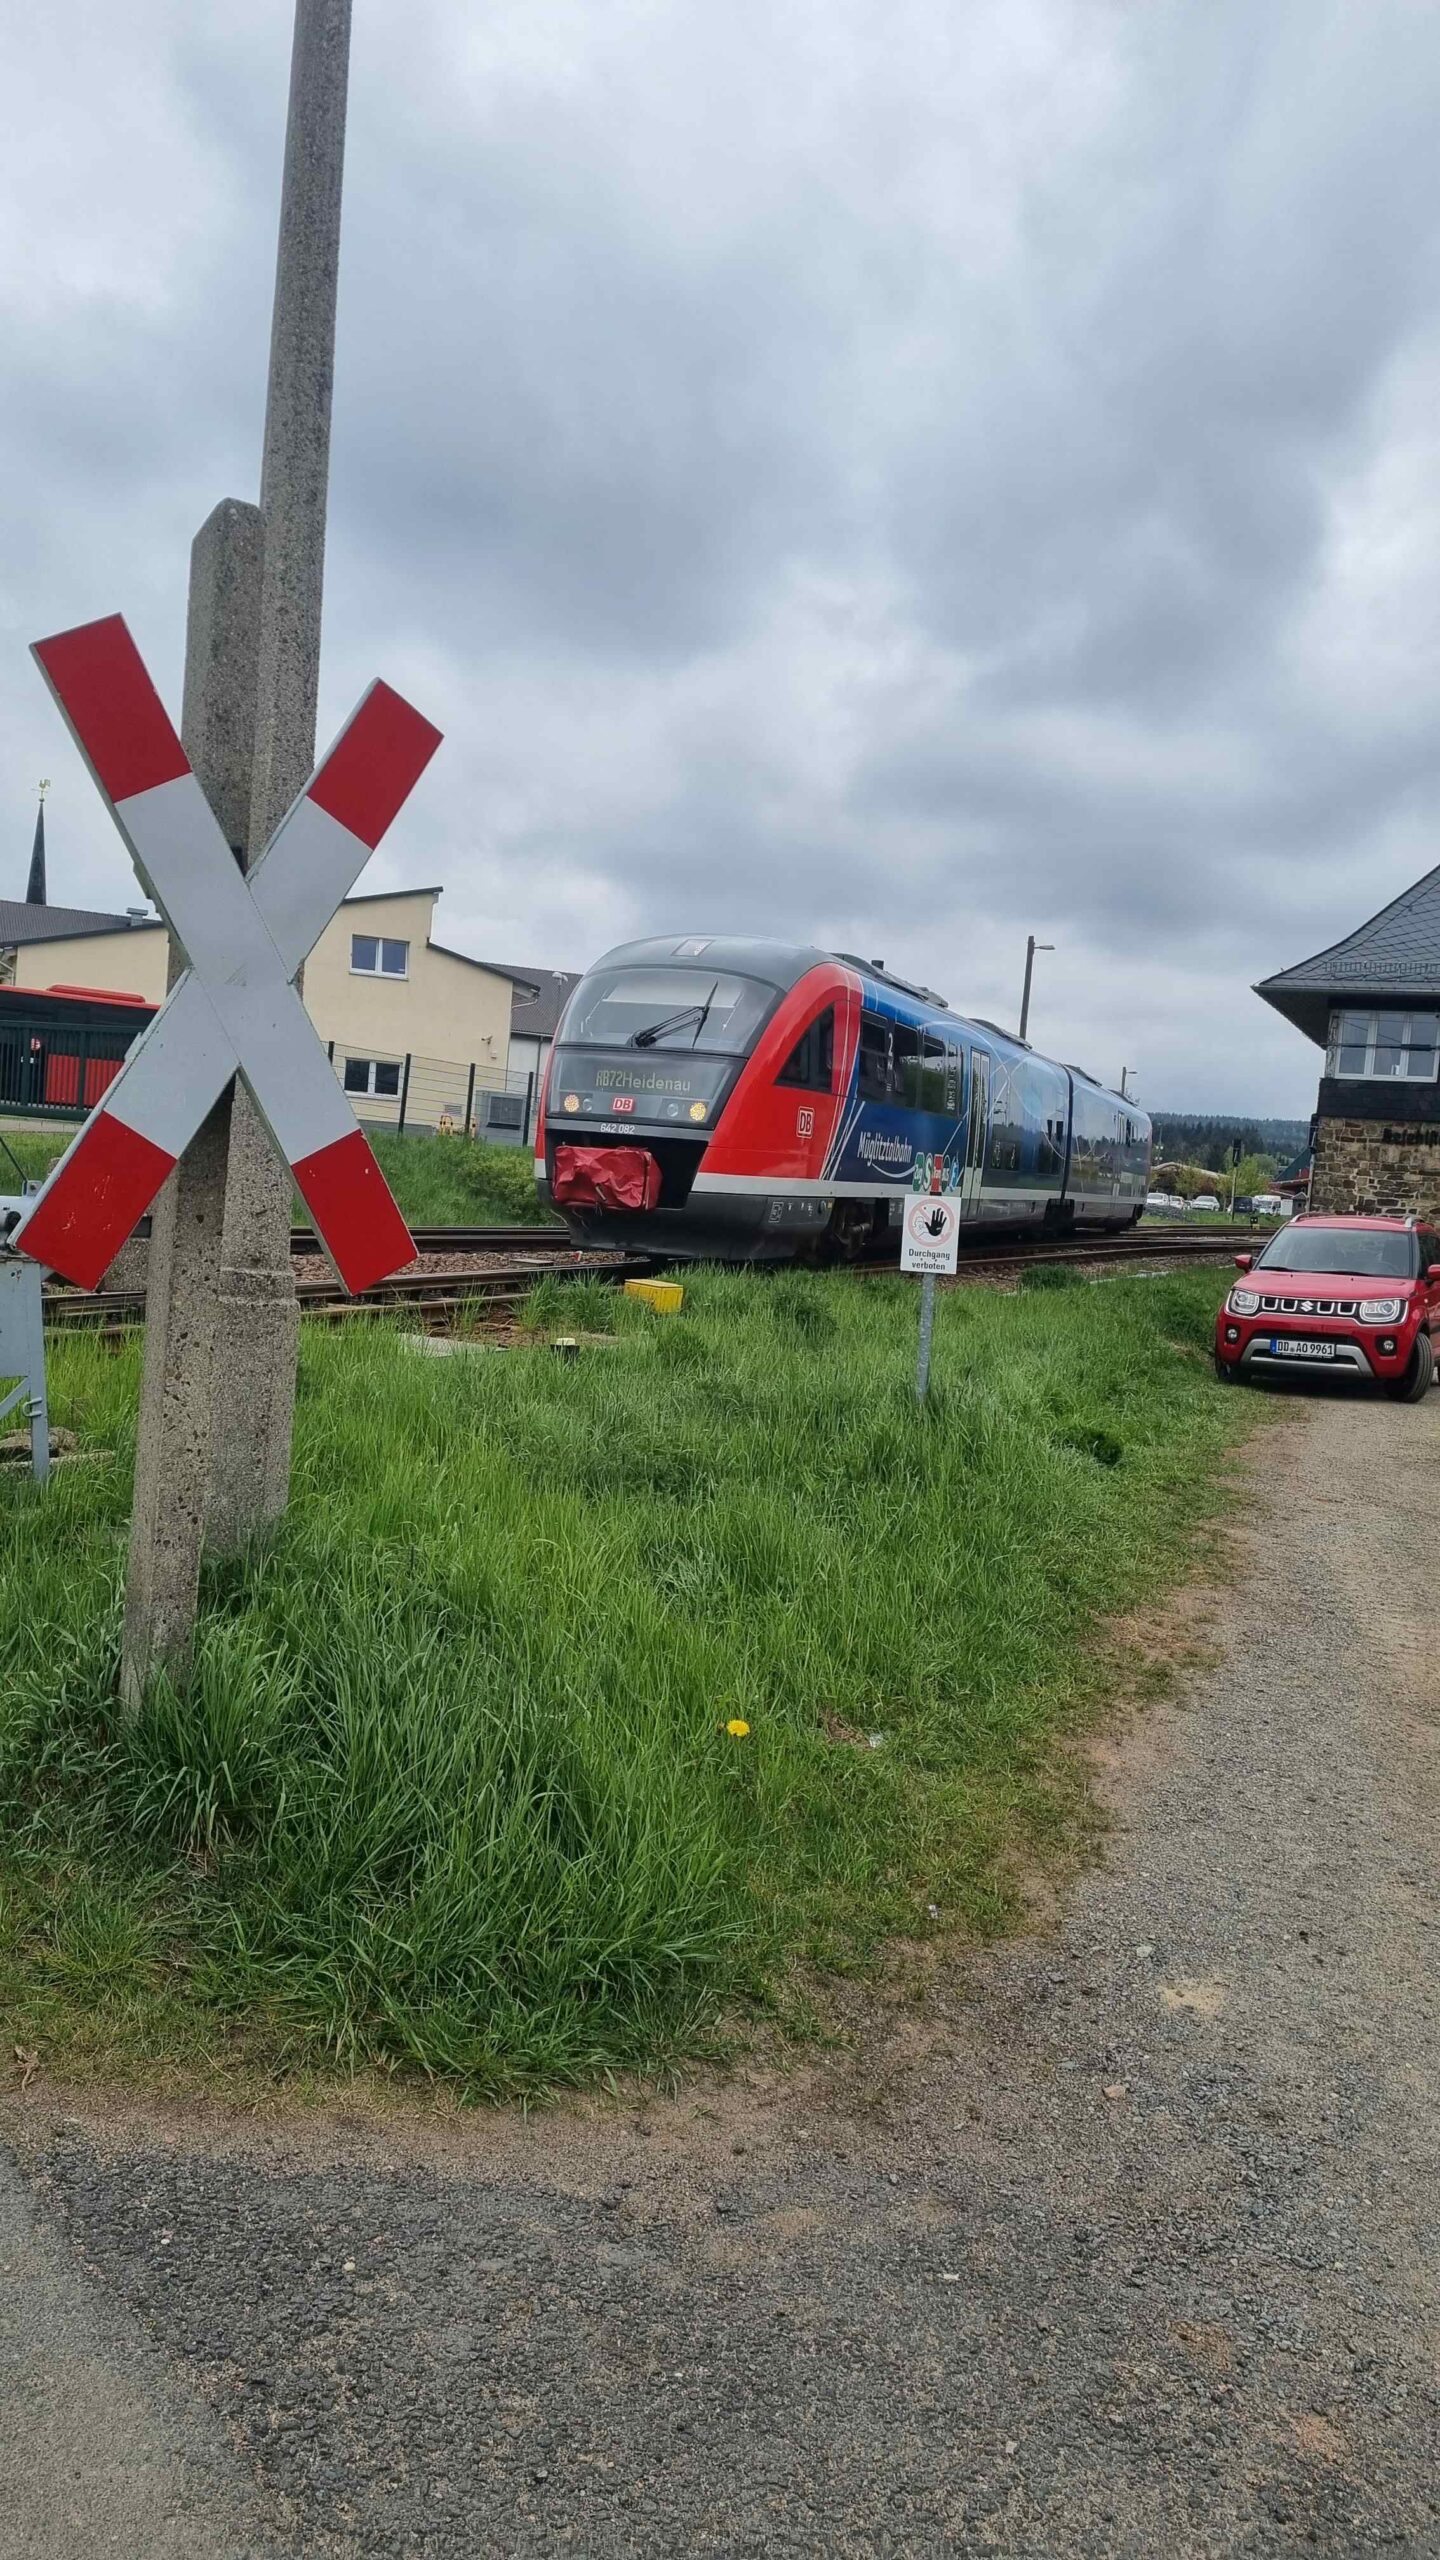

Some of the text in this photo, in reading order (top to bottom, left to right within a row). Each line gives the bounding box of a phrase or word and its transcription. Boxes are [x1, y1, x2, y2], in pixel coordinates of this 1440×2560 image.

[888, 1033, 894, 1057] 2
[623, 1072, 691, 1092] Heidenau
[600, 1123, 636, 1135] 642 082
[857, 1131, 913, 1167] Müglitztalbahn
[909, 1249, 950, 1261] Durchgang
[912, 1262, 946, 1271] verboten
[1277, 1341, 1290, 1352] DD
[1310, 1343, 1333, 1355] 9961
